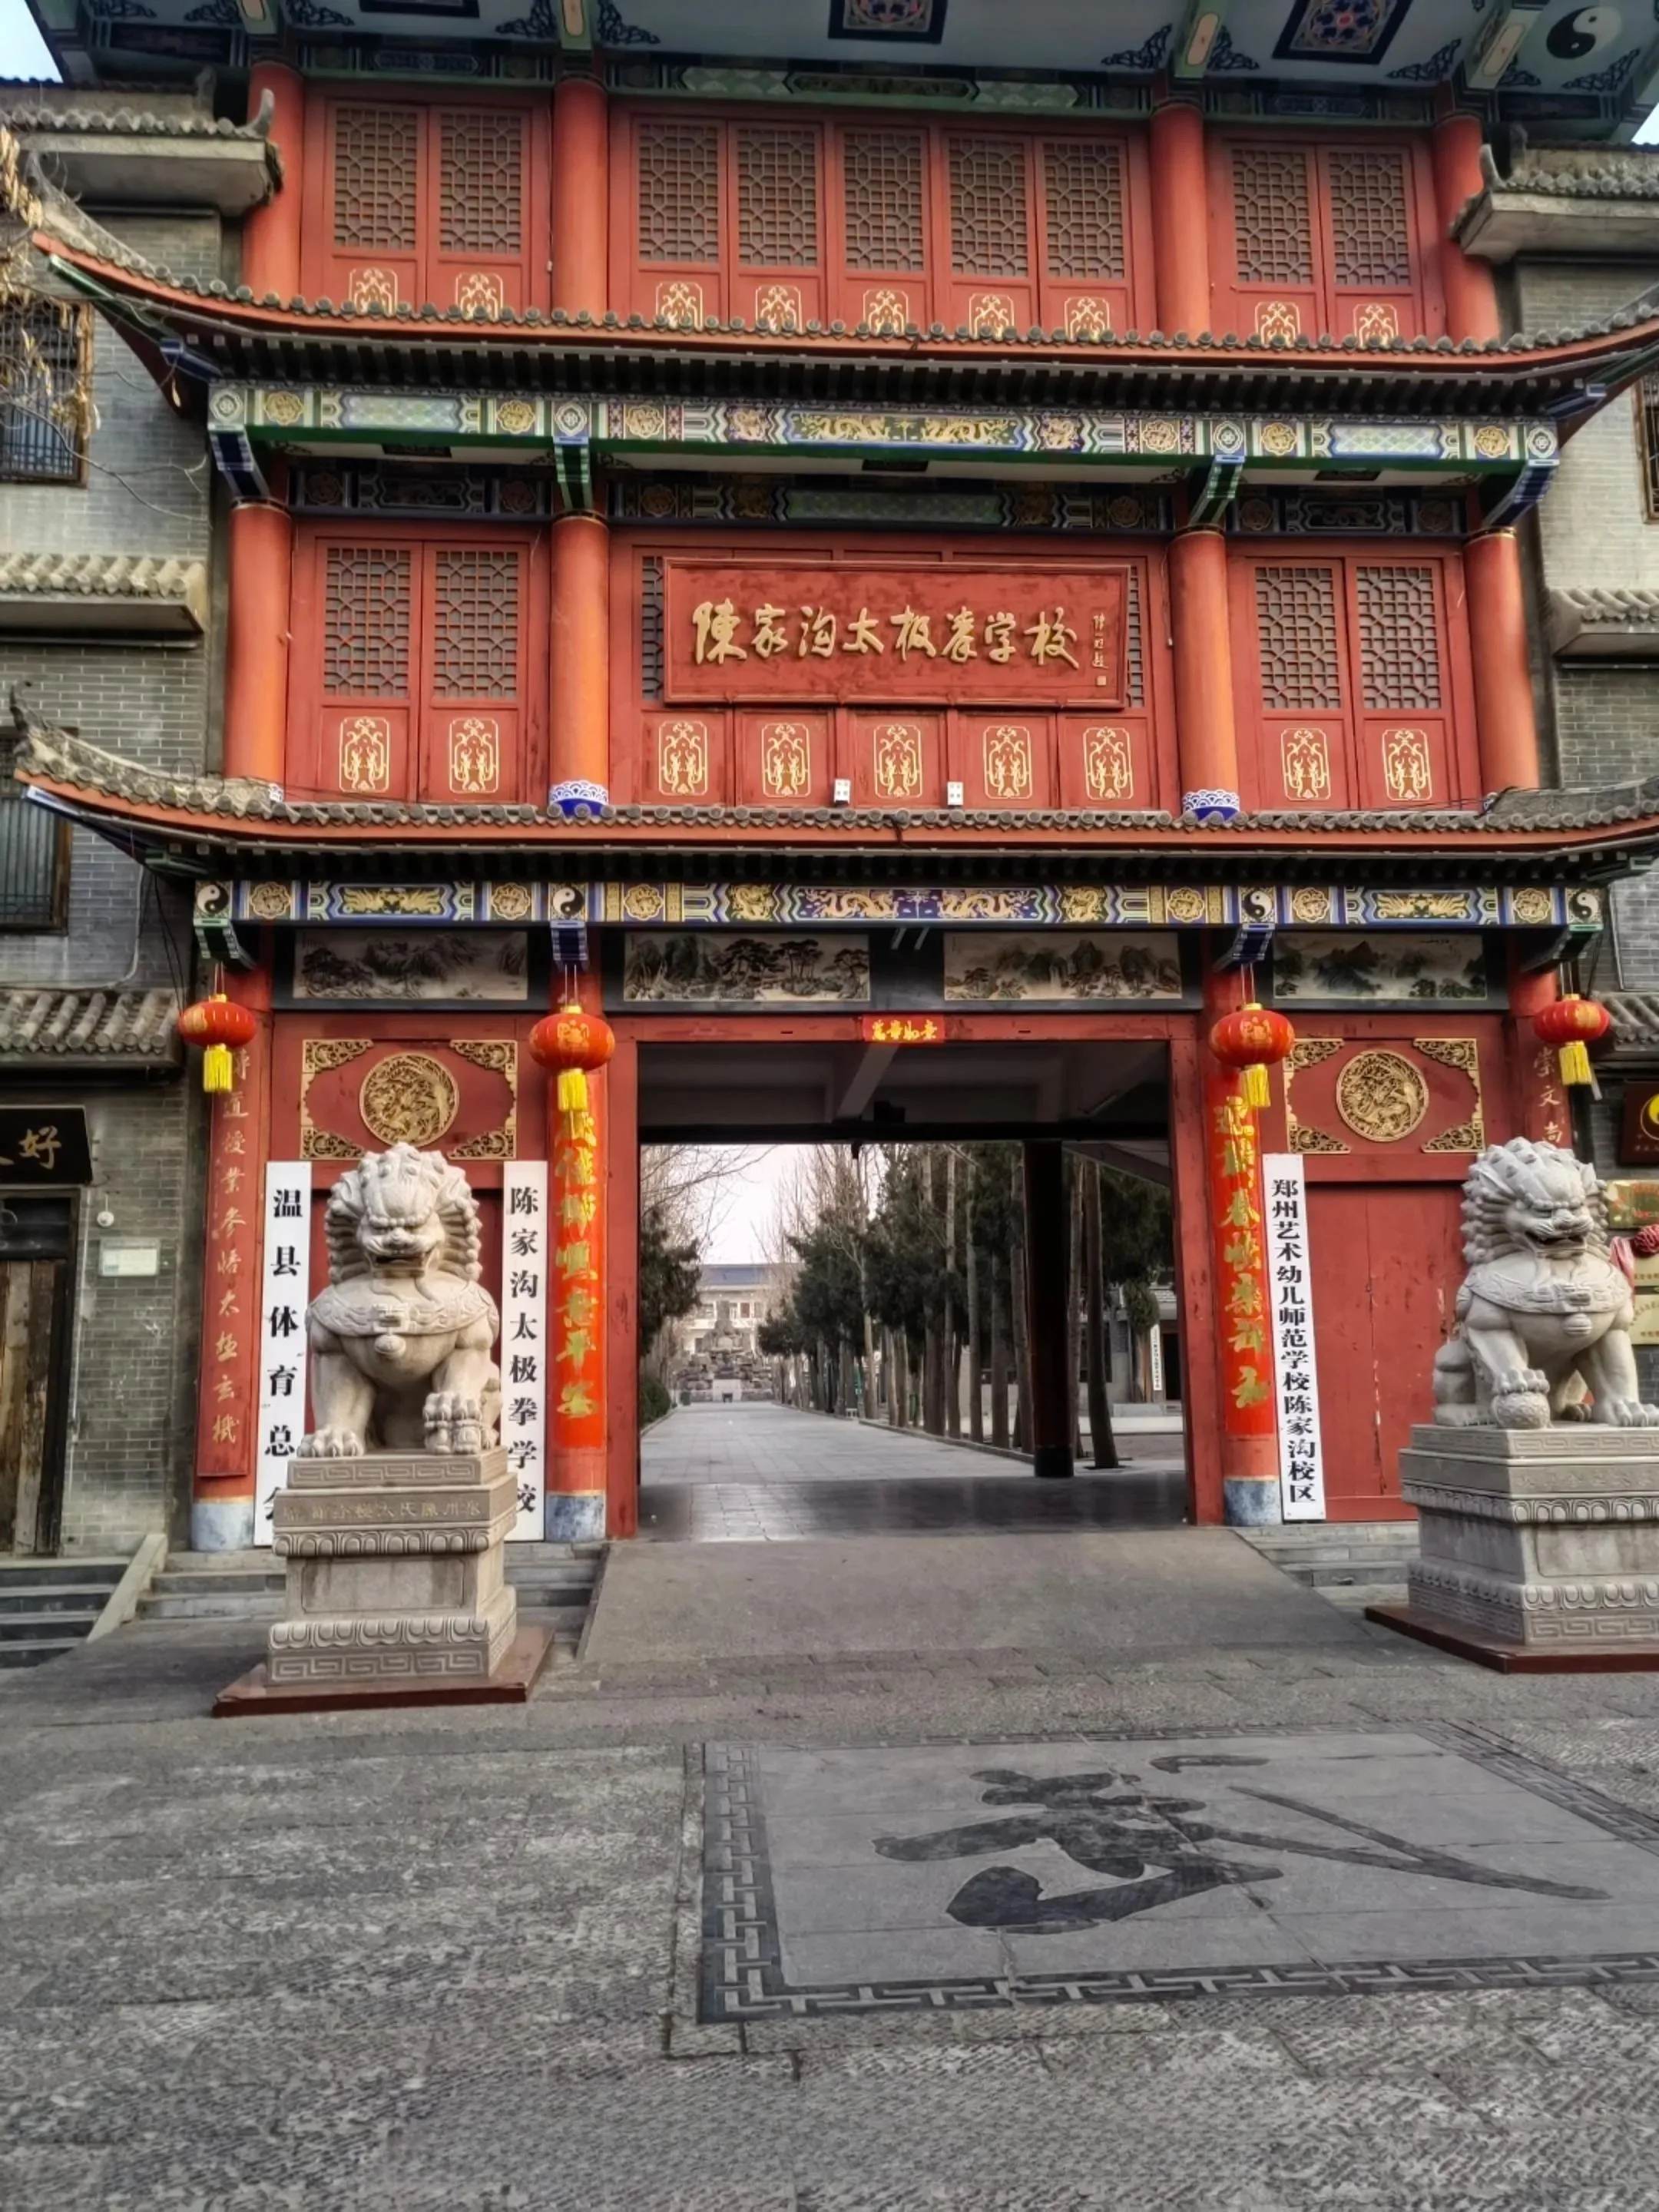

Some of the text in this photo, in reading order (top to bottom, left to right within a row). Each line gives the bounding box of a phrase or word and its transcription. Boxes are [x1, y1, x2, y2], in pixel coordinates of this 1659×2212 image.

[507, 1187, 539, 1514] 陈家沟太极拳学校
[1270, 1178, 1316, 1503] 郑州艺术幼儿师范学校陈家沟校区
